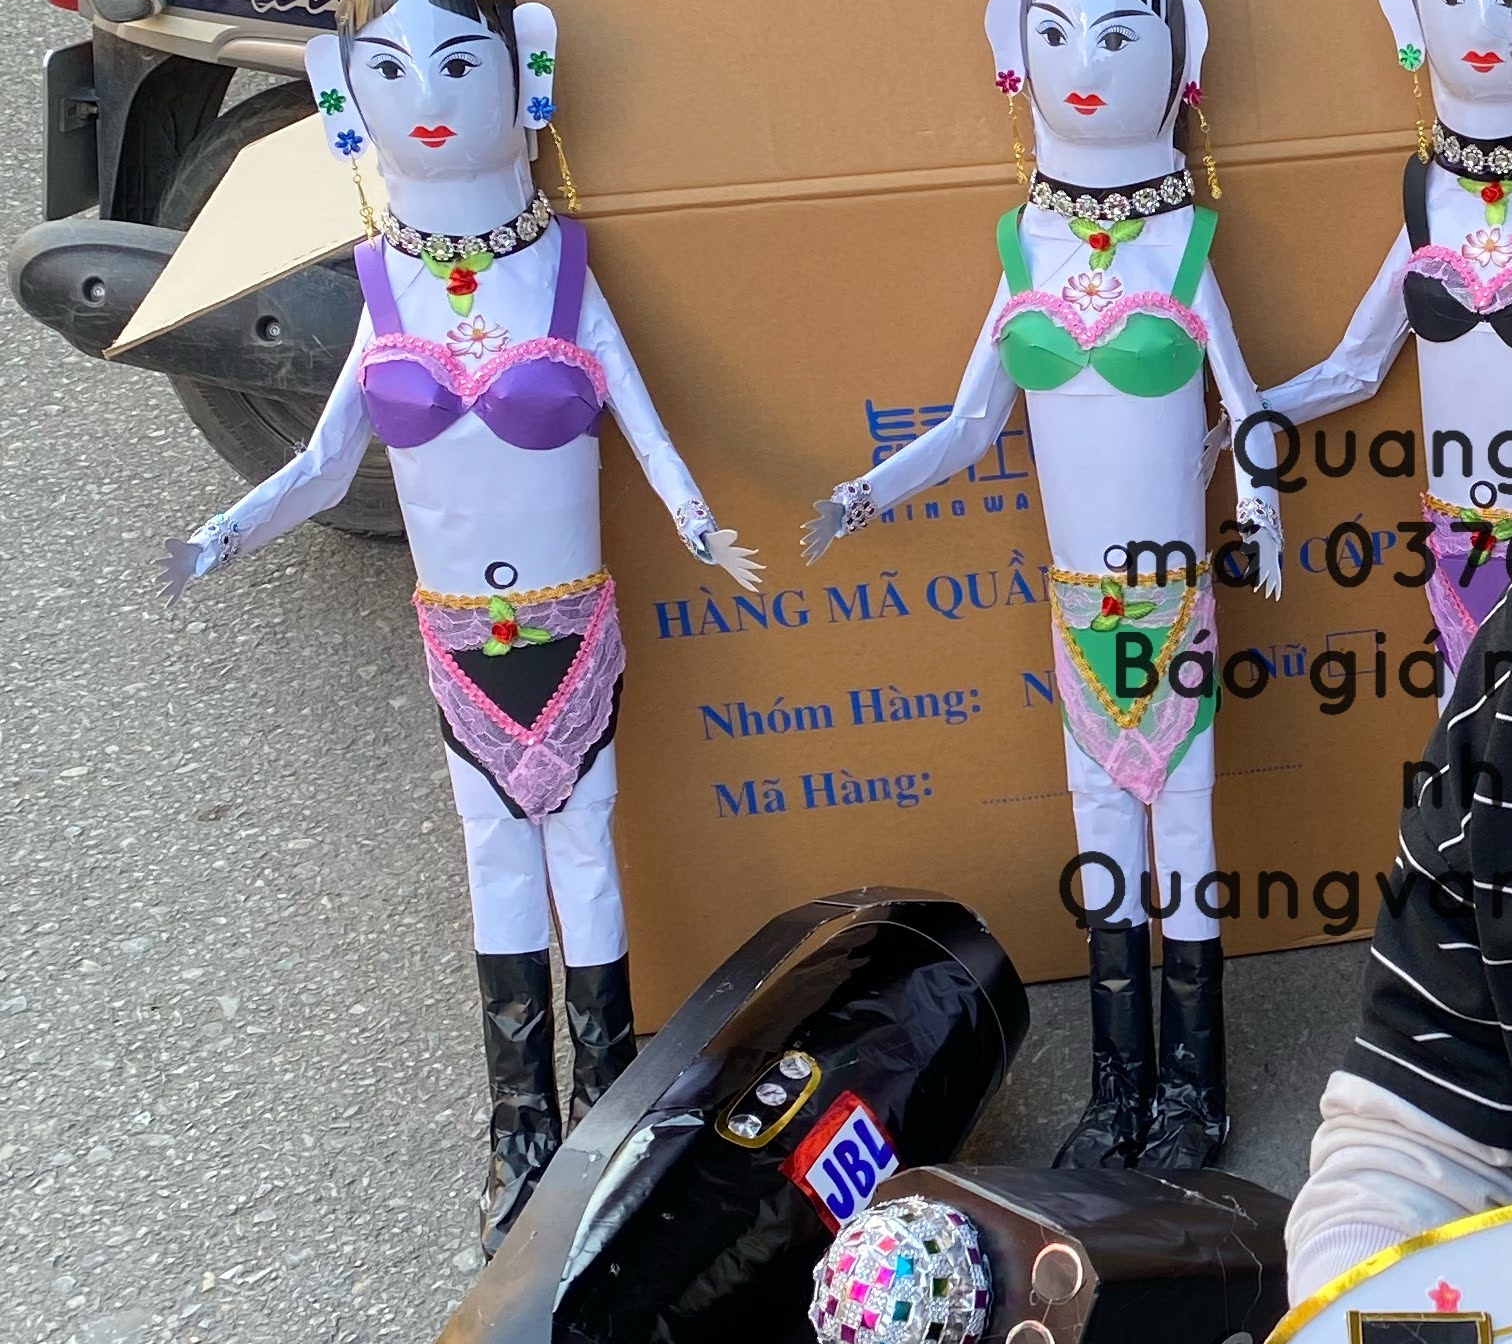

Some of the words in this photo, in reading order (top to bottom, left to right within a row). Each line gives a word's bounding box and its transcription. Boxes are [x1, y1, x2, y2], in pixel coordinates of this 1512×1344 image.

[652, 585, 810, 640] HÀNG
[823, 570, 912, 624] MÃ
[697, 696, 835, 741] Nhóm
[847, 684, 982, 726] Hàng:
[710, 777, 788, 819] Mã
[799, 768, 934, 808] Hàng:
[822, 1118, 894, 1220] JBL
